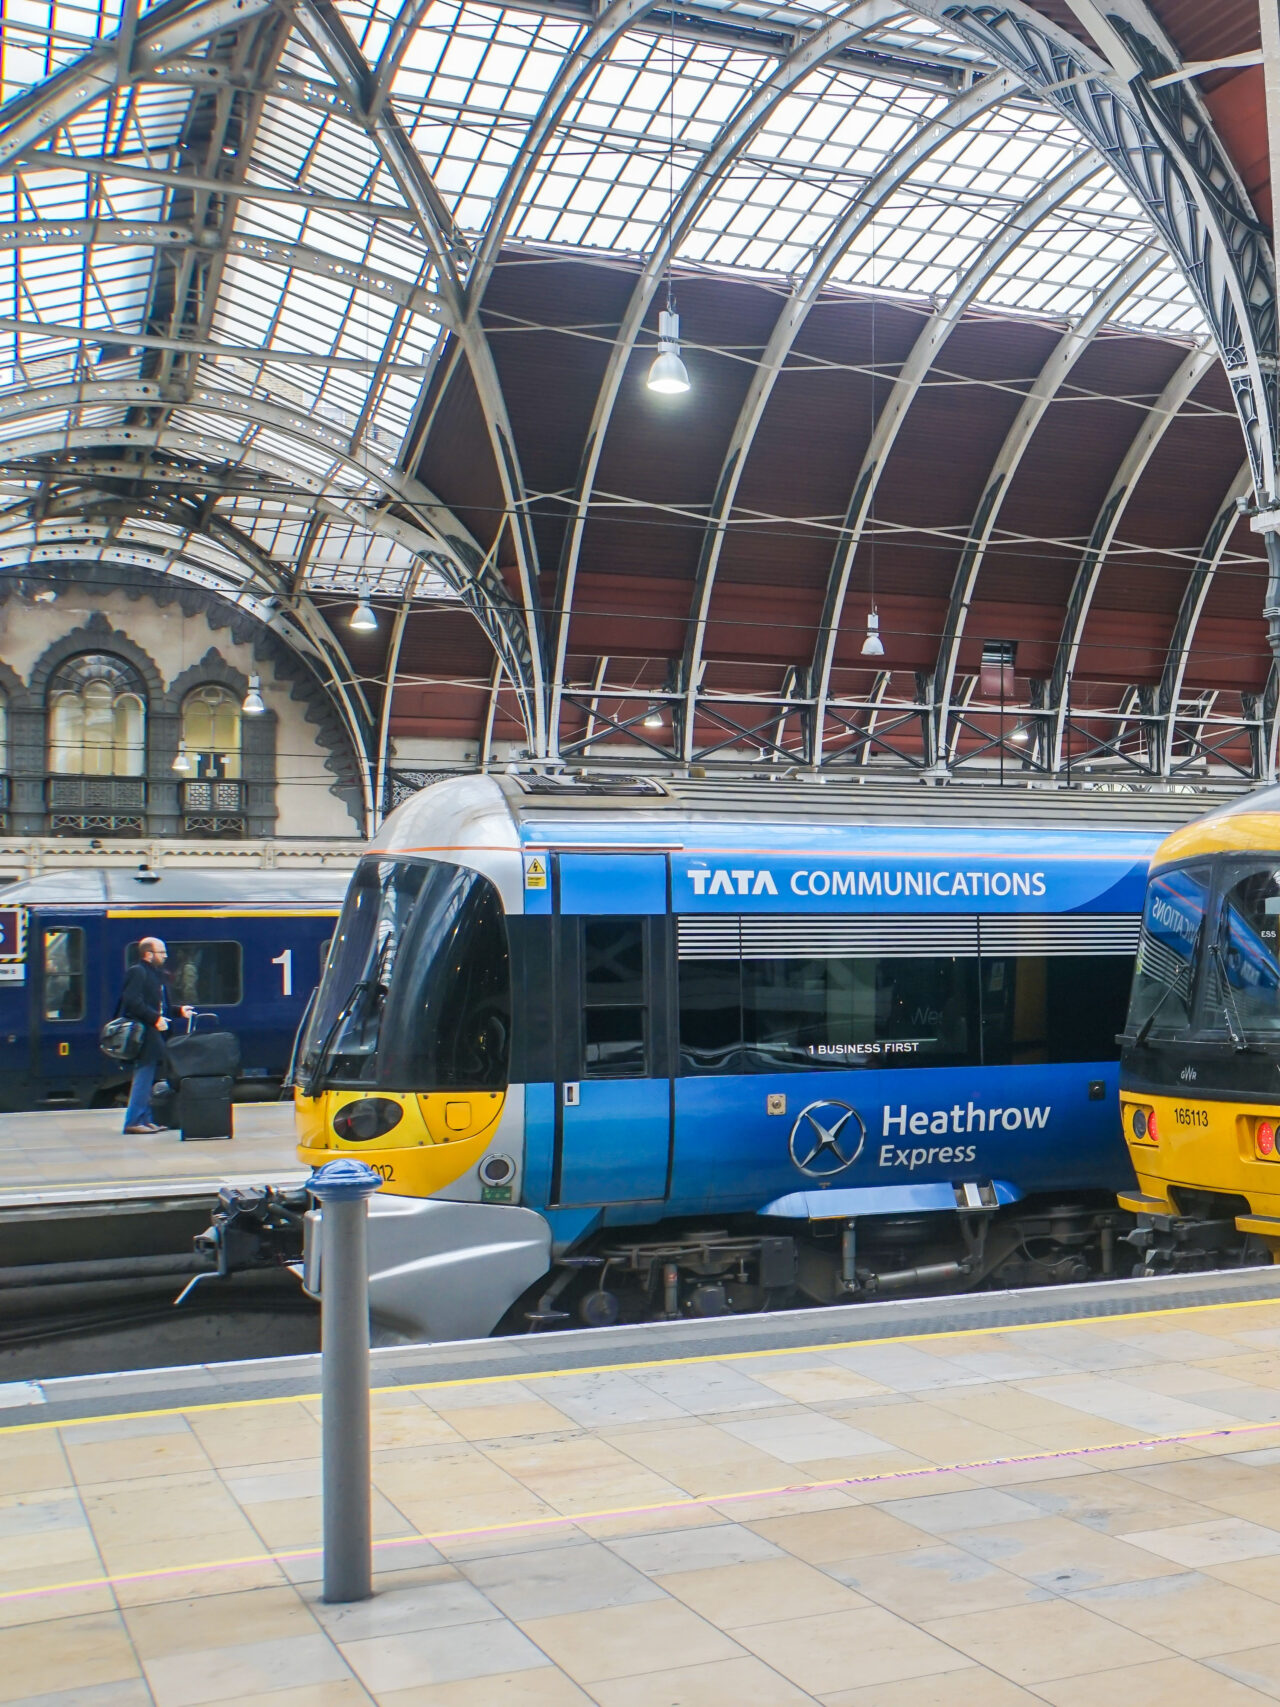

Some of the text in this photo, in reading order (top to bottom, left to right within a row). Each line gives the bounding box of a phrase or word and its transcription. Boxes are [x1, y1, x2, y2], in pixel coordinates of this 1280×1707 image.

[687, 869, 1047, 897] TATA COMMUNICATIONS
[271, 949, 292, 996] 1
[808, 1042, 919, 1055] 1 BUSINESS FIRST
[1180, 1065, 1197, 1081] GWR
[882, 1101, 1052, 1137] Heathrow
[1174, 1107, 1209, 1127] 165113
[878, 1144, 977, 1171] Express
